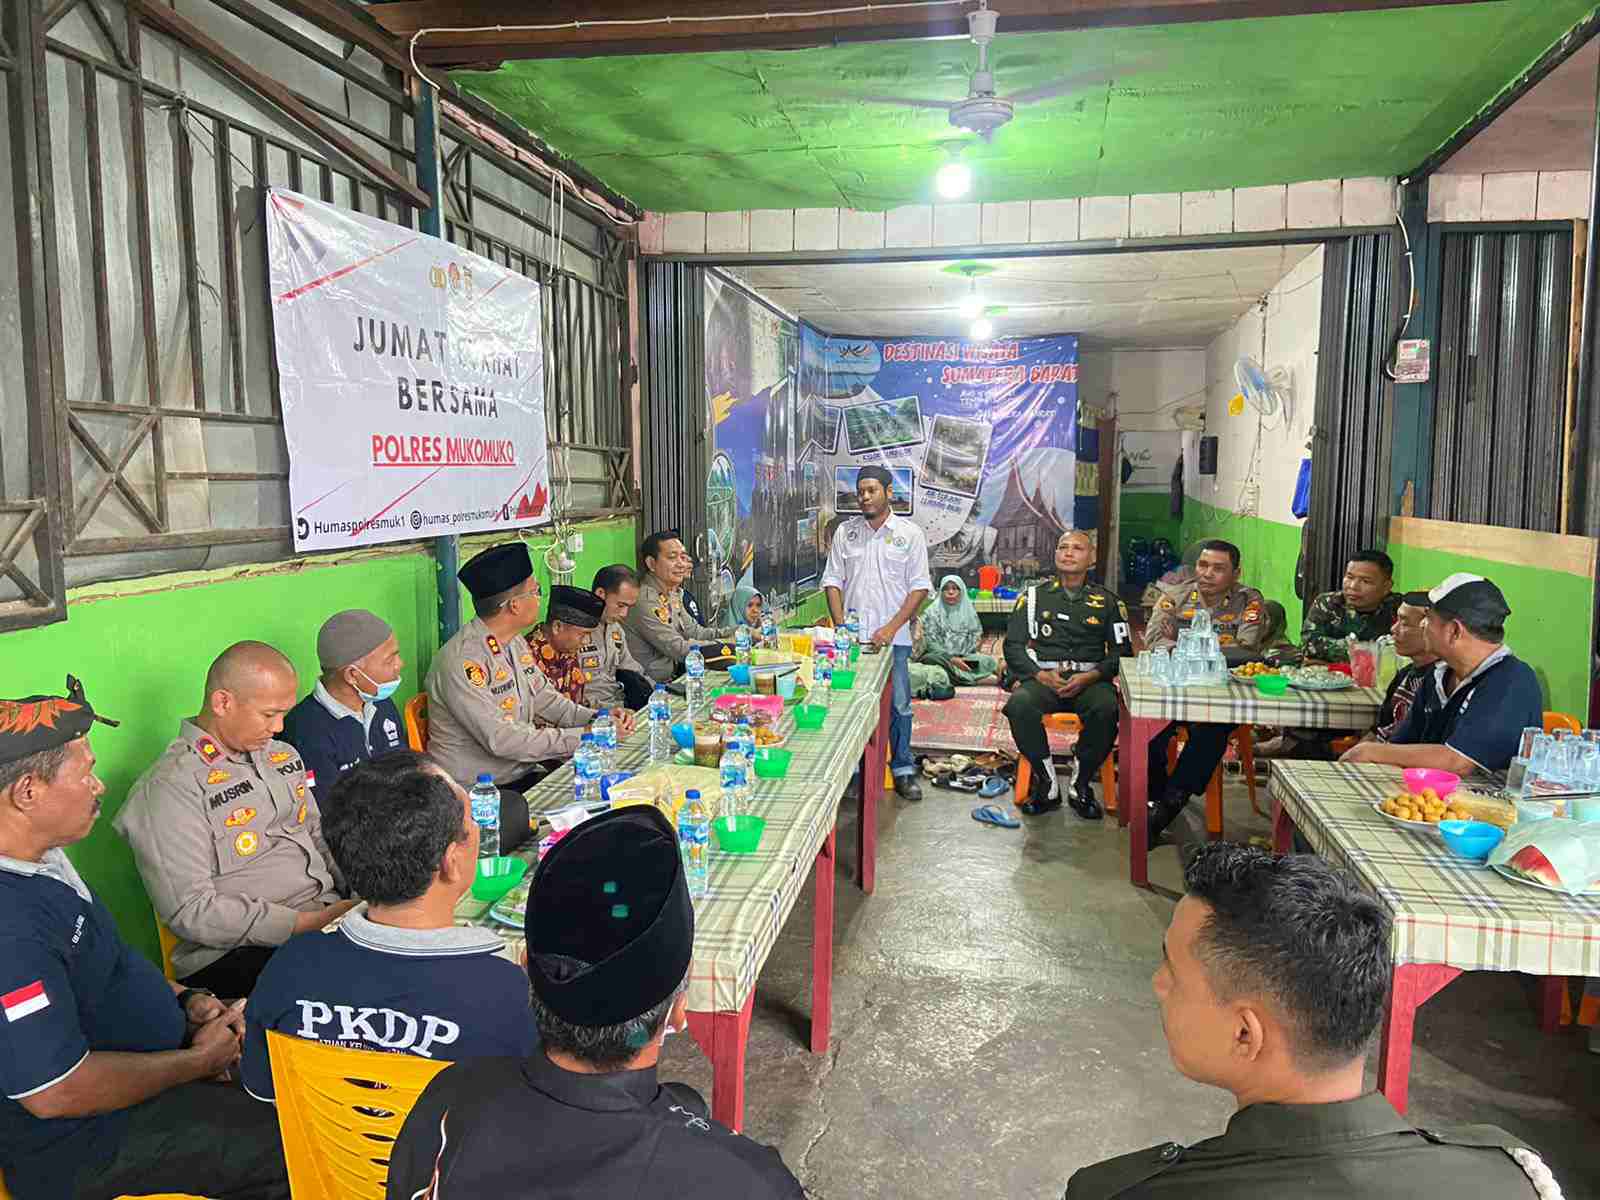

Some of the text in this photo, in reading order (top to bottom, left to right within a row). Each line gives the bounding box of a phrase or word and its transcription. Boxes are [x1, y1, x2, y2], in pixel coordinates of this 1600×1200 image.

[353, 316, 447, 362] JUMAT
[884, 341, 961, 361] DESTINASI
[397, 376, 498, 418] BERSAMA
[372, 434, 514, 463] POLRES MUKOMUKO
[209, 780, 254, 810] MUSRIN
[296, 999, 460, 1057] PKDP
